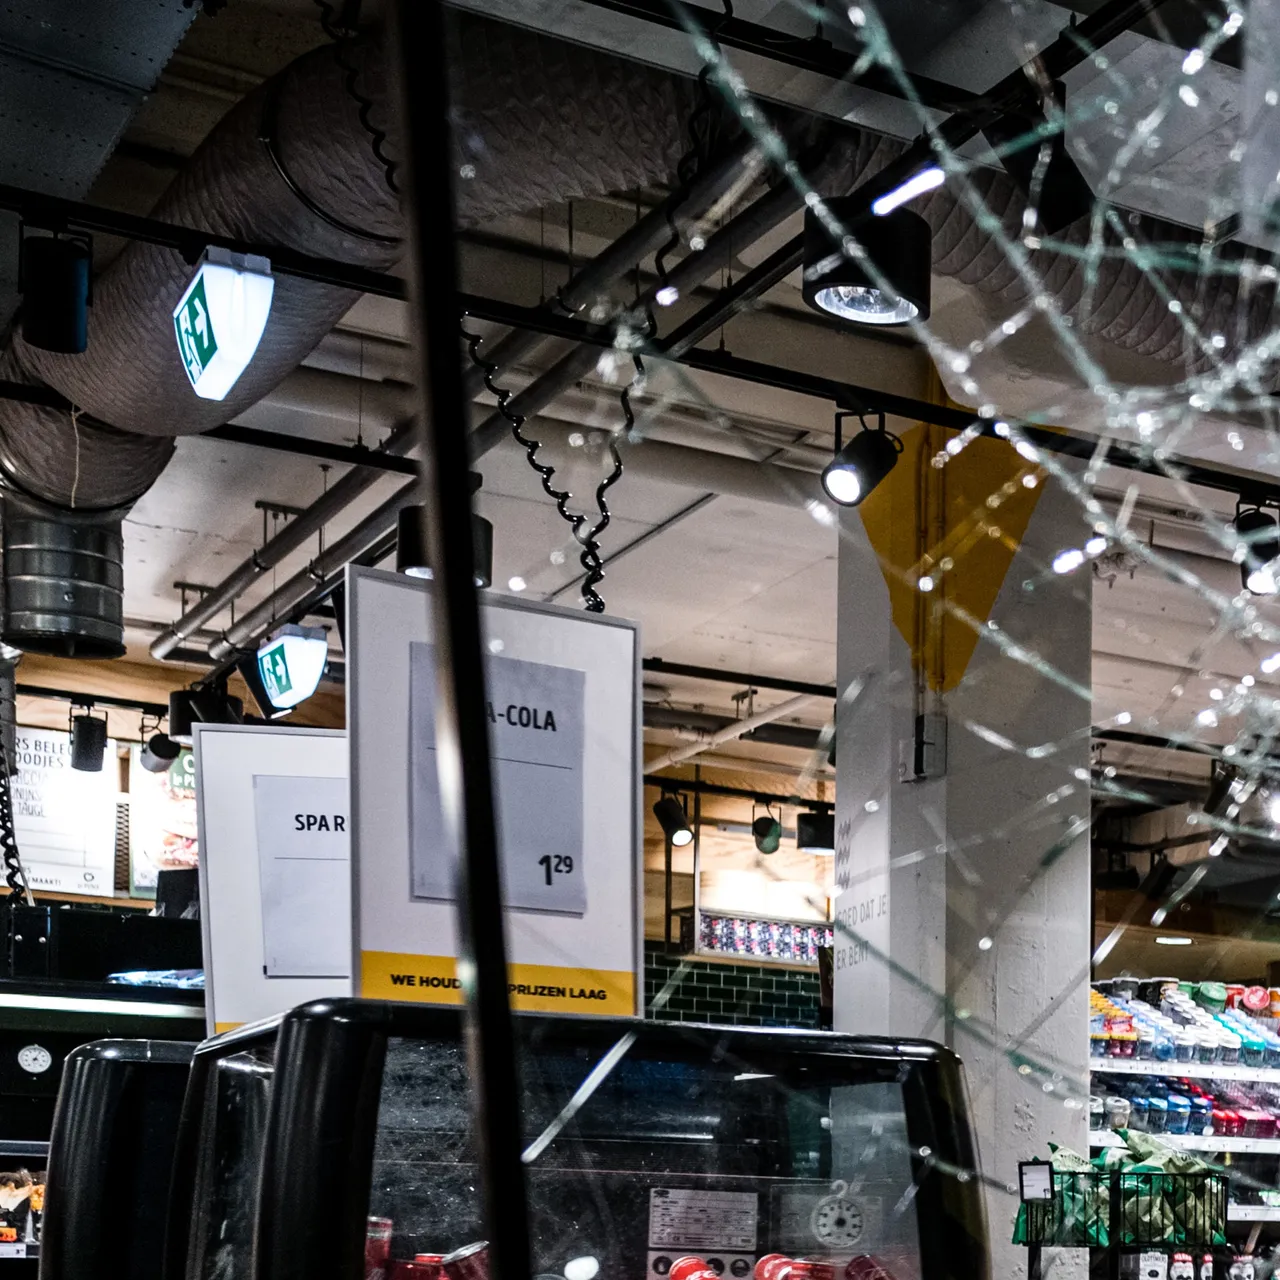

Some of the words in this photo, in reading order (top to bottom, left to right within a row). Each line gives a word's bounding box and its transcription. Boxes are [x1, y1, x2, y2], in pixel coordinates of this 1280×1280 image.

[295, 814, 331, 832] SPA
[877, 893, 887, 918] JE
[836, 949, 847, 970] ER
[390, 974, 416, 987] WE
[420, 976, 462, 989] HOUD
[508, 984, 566, 999] PRIJZEN
[570, 987, 607, 1001] LAAG
